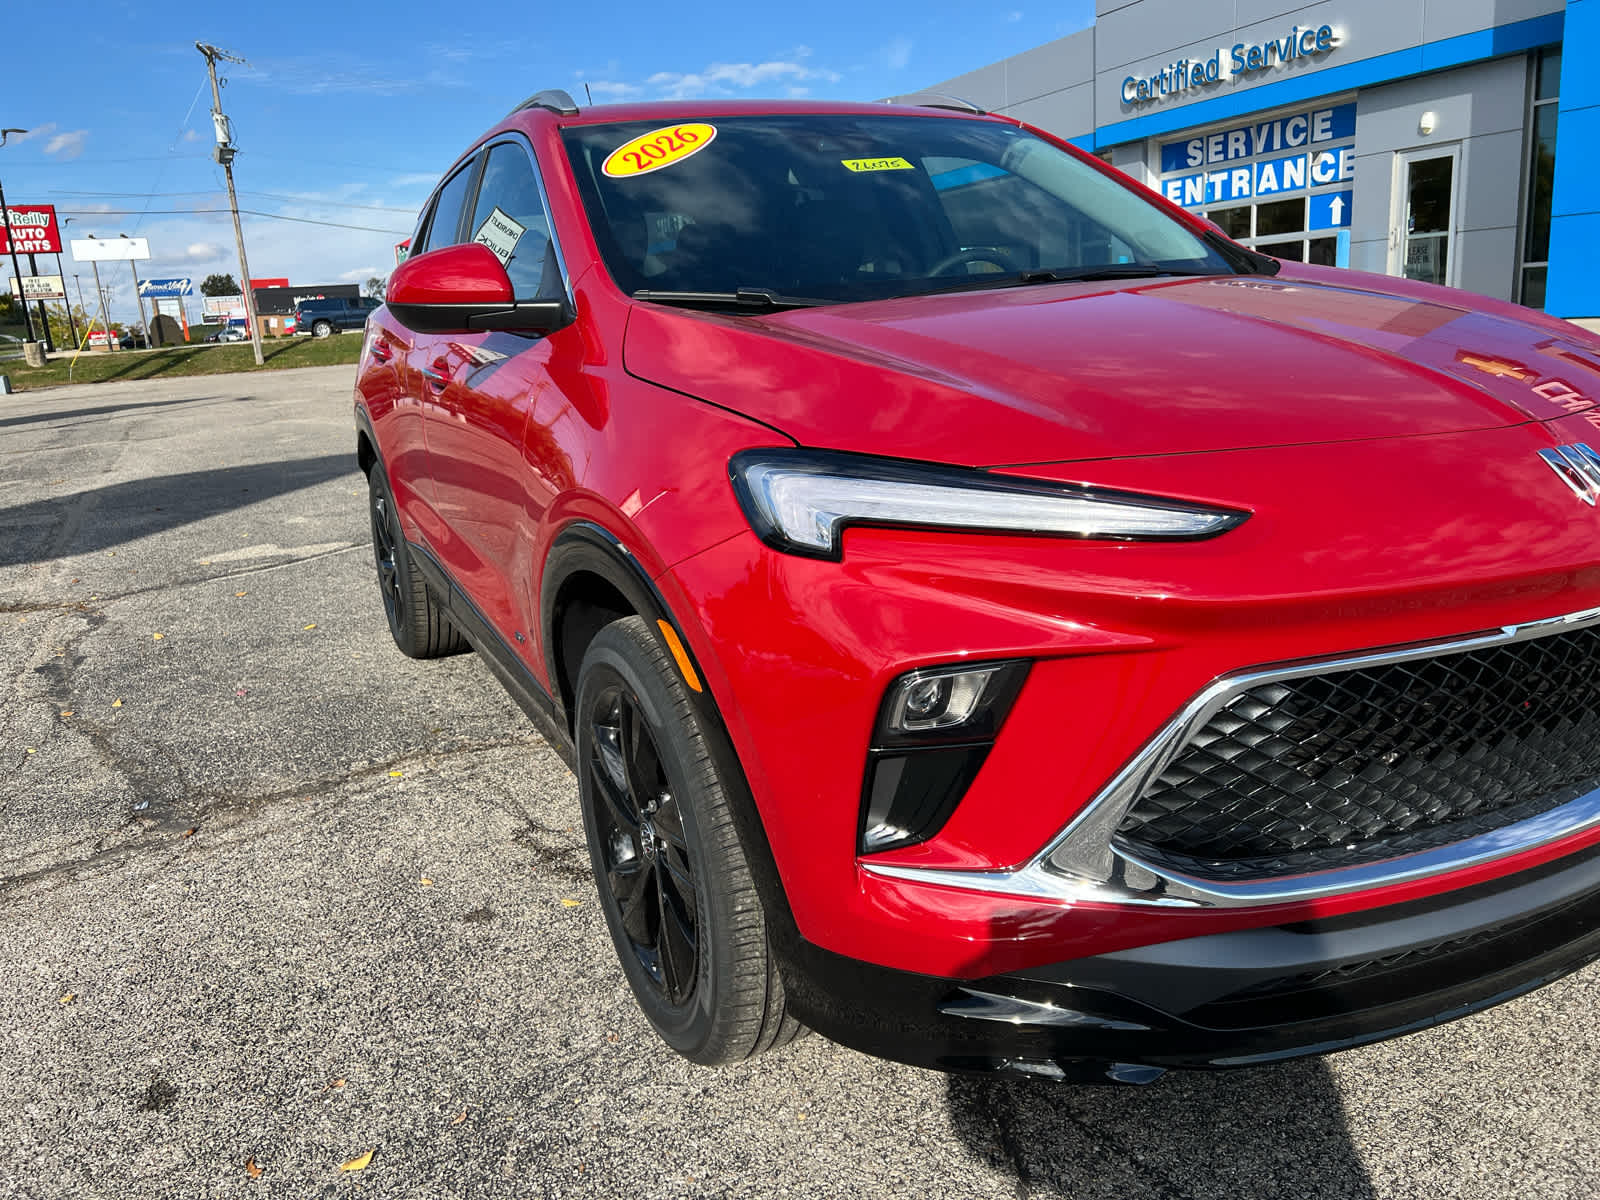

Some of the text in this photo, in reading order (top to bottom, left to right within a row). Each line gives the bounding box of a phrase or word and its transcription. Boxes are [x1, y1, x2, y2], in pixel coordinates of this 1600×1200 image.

[1121, 24, 1333, 104] Certified Service
[622, 127, 699, 170] 2026
[1186, 109, 1333, 168] SERVICE
[1167, 149, 1355, 207] ENTRANCE
[11, 228, 46, 239] AUTO
